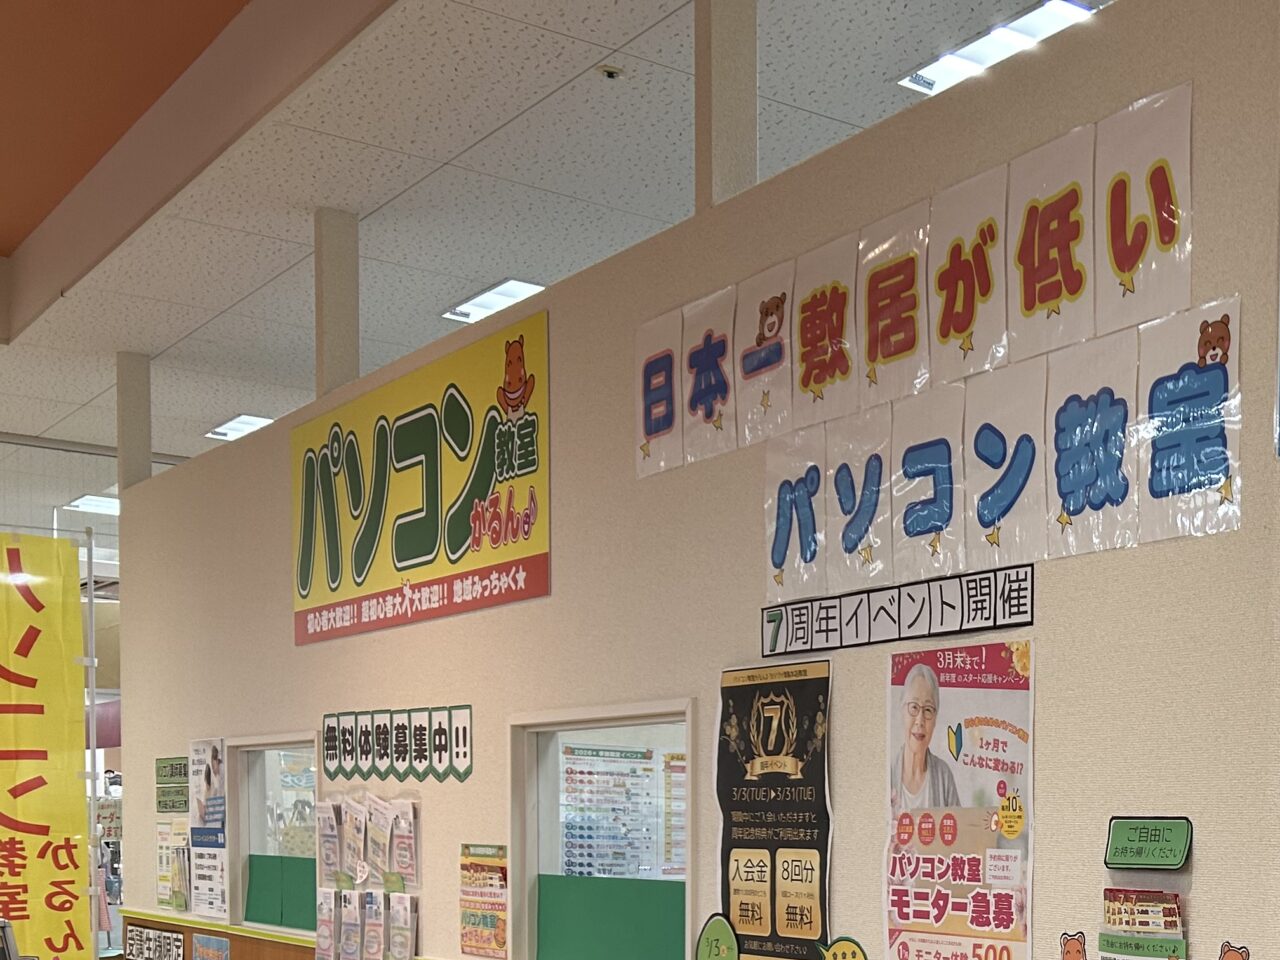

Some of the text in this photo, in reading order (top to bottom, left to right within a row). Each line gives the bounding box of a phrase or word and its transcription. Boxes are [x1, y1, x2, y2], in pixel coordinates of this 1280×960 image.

[641, 159, 1181, 440] 日本一敷居が低い
[494, 412, 539, 482] 教室
[771, 362, 1229, 569] パソコン教室
[298, 384, 501, 597] パソコン
[765, 571, 1031, 654] 7周年イベント開催
[937, 646, 986, 670] 3月末まで!
[325, 721, 467, 764] 無料体験募集中!!
[764, 705, 782, 751] 7
[732, 787, 816, 802] 3/3(TUE) 3/31(TUE)
[1127, 825, 1172, 843] ご自由に
[1113, 846, 1182, 859] お持ち帰りください
[732, 859, 768, 883] 入会金
[781, 859, 815, 883] 8回分
[890, 854, 982, 883] パソコン教室
[739, 901, 763, 926] 無料
[785, 904, 813, 930] 無料
[891, 888, 1014, 929] モニター急募
